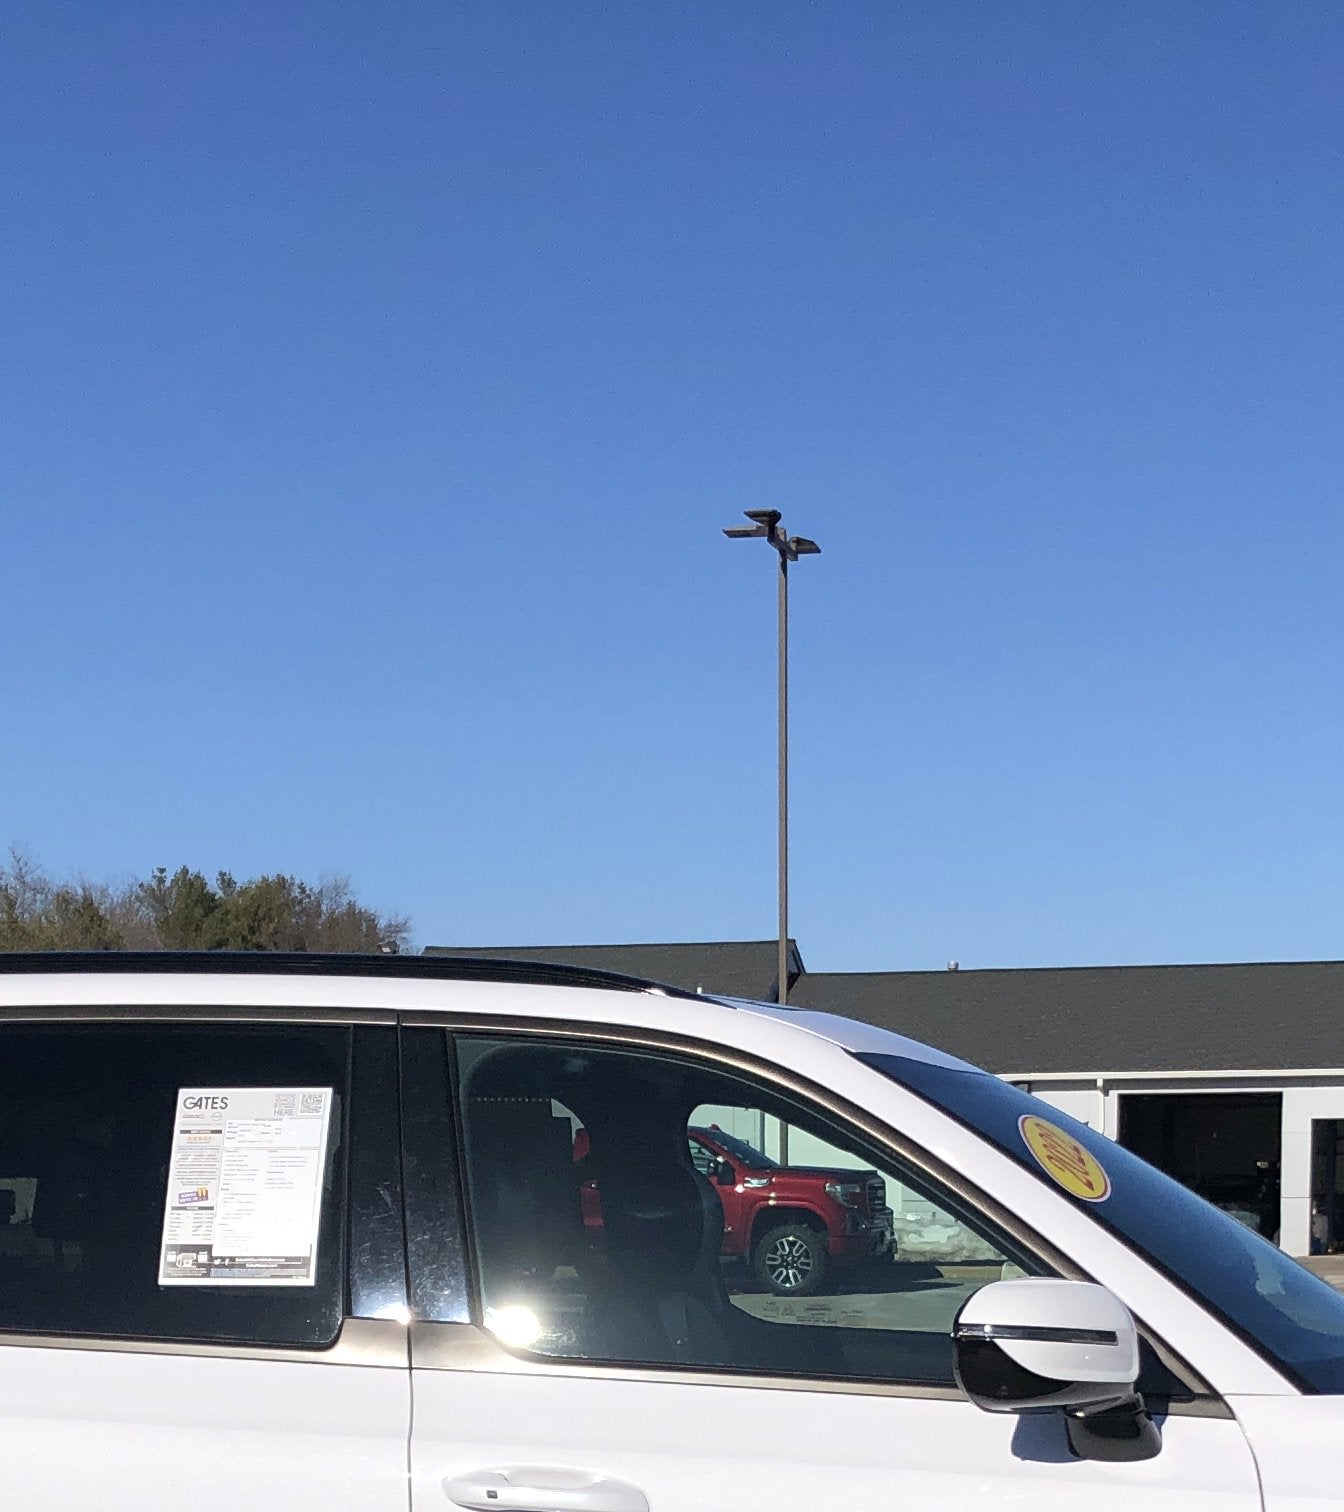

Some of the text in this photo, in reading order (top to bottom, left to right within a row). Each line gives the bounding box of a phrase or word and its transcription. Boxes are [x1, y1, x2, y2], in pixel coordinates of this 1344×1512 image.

[183, 1096, 228, 1110] GATES
[274, 1108, 294, 1116] HERE
[1034, 1122, 1095, 1191] 2022
